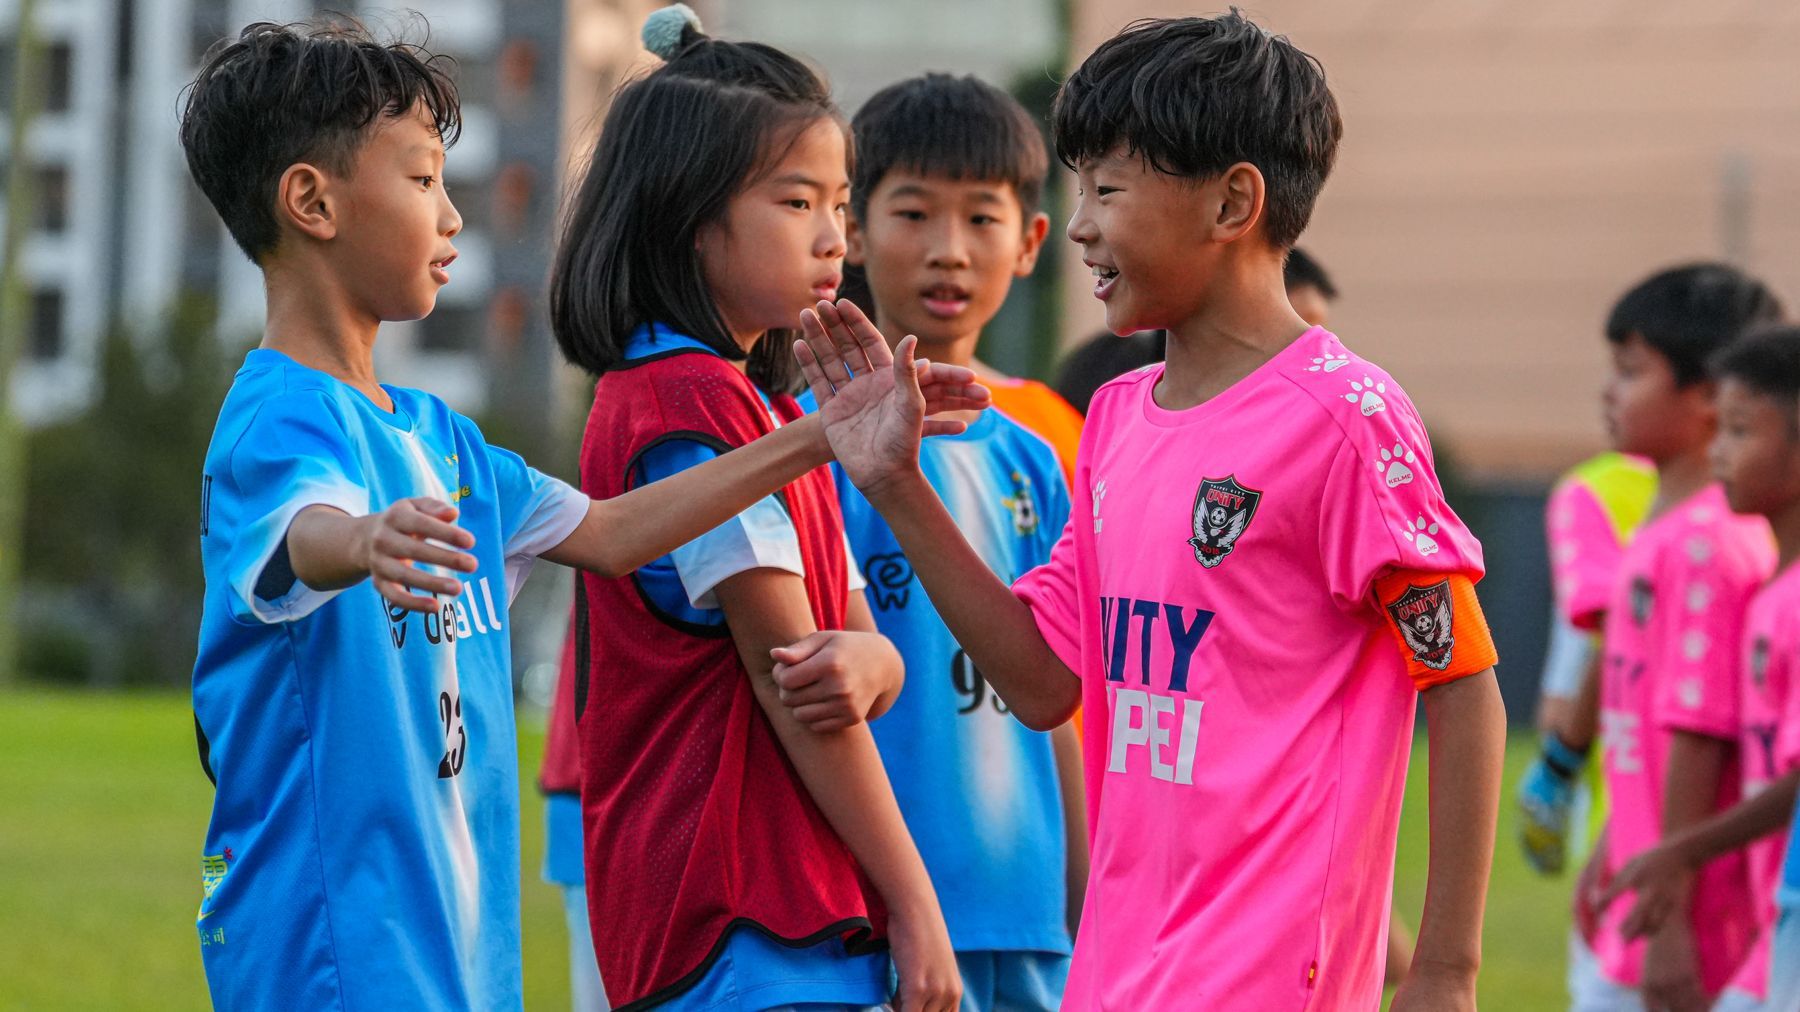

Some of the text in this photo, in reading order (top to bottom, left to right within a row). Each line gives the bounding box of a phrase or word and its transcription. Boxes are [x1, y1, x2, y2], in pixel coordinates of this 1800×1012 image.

[1388, 473, 1412, 485] KELME
[1206, 488, 1246, 511] UNITY
[1398, 592, 1438, 621] UNITY
[1106, 684, 1205, 786] PEI
